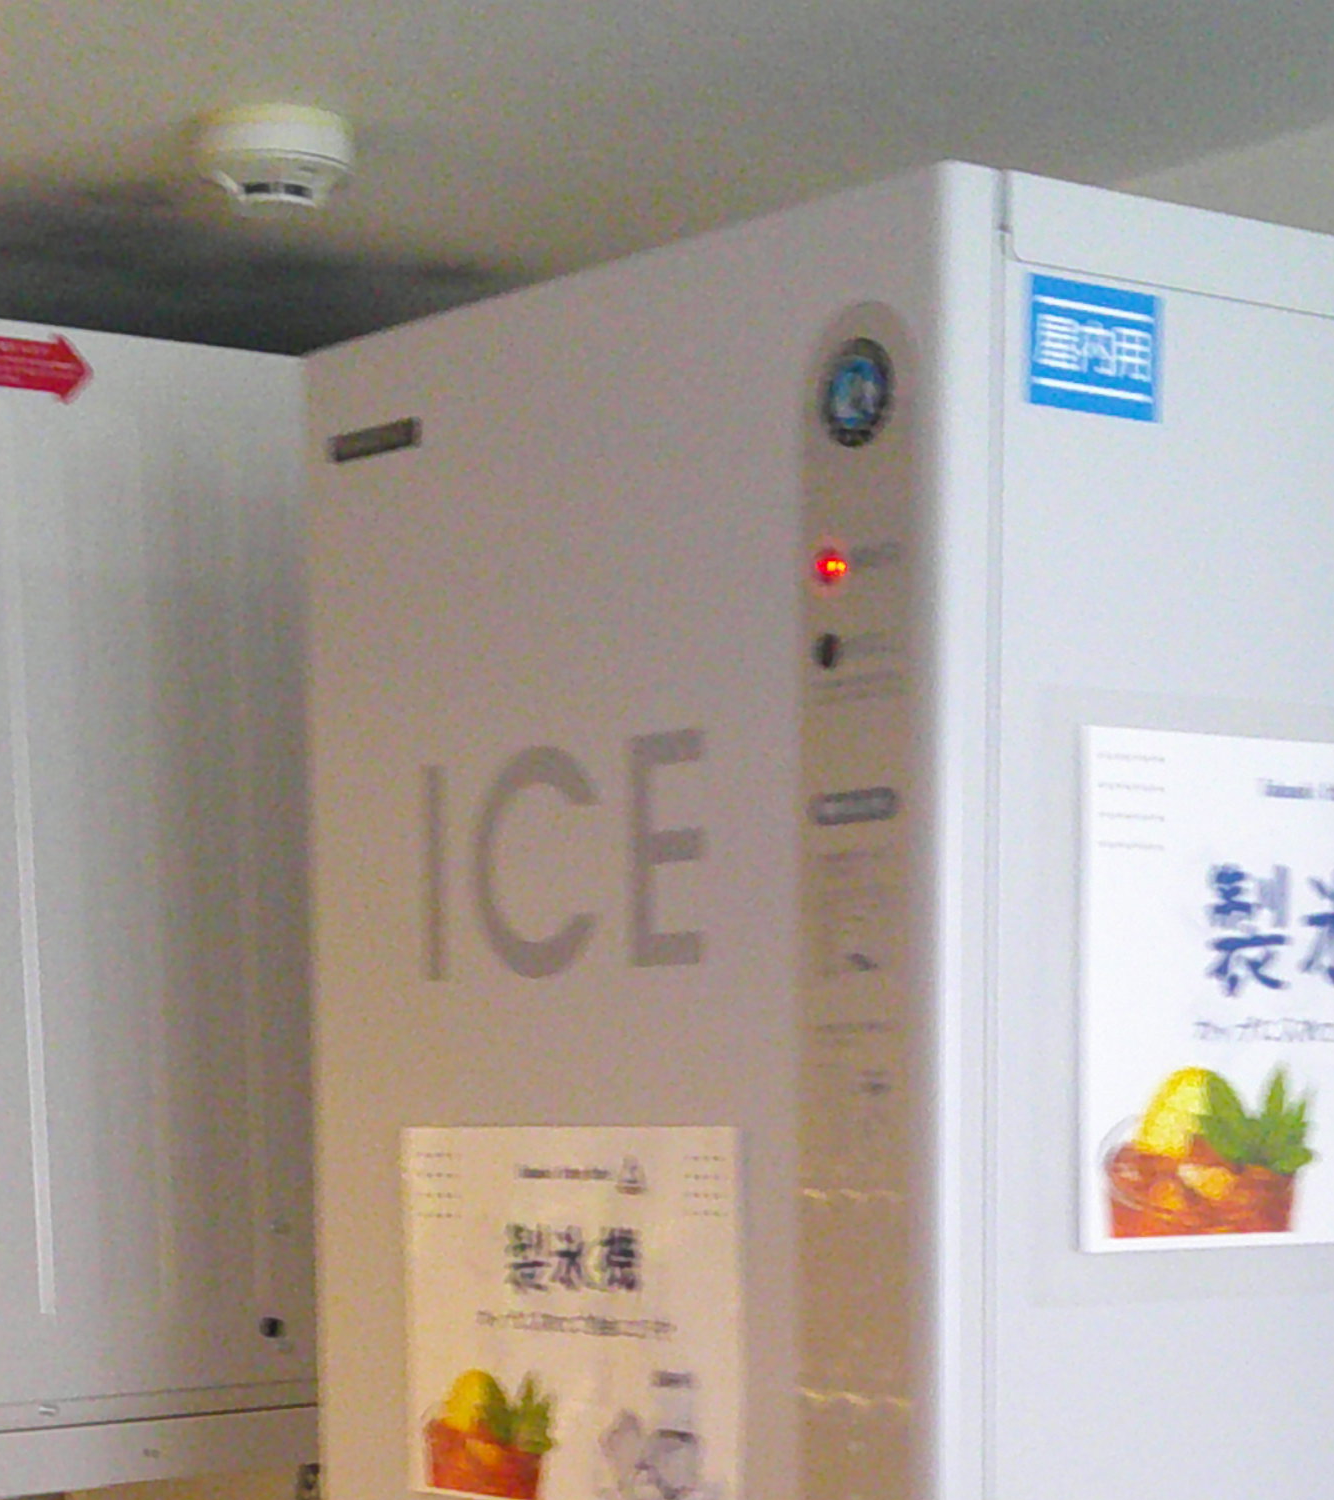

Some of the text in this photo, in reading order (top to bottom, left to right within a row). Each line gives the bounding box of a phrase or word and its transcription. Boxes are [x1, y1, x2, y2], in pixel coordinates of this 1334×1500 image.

[1035, 312, 1152, 383] 屋内用
[419, 729, 706, 981] ICE
